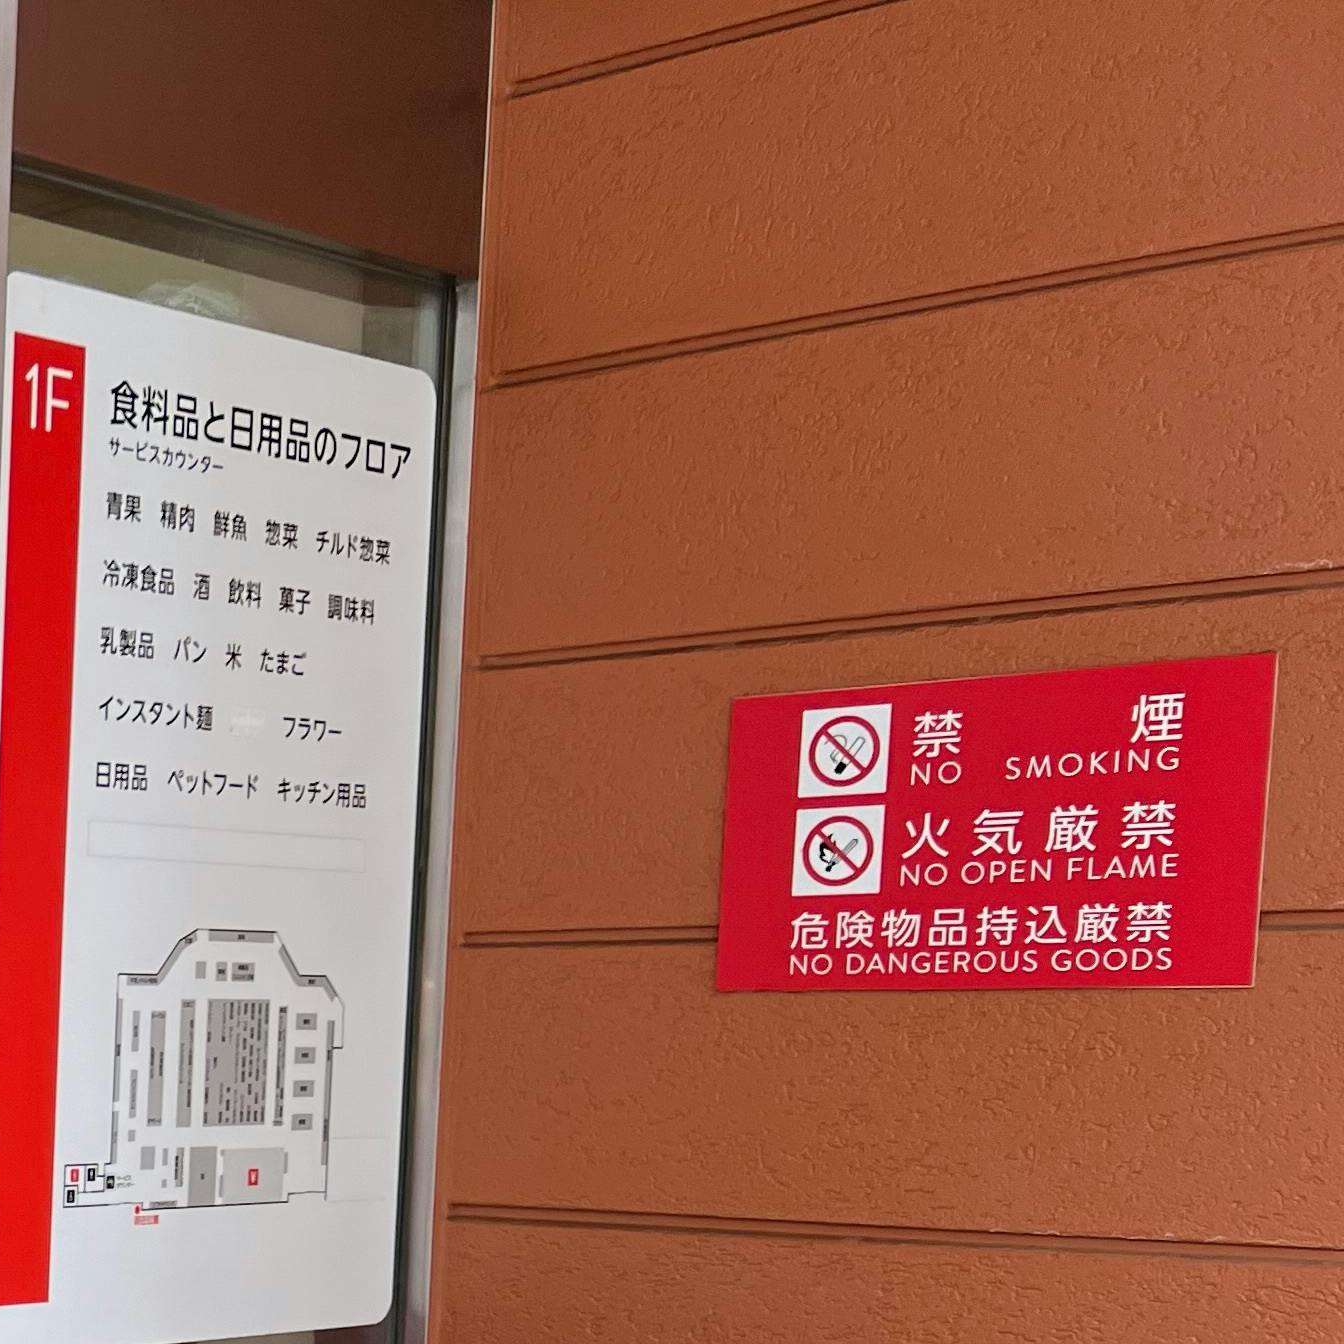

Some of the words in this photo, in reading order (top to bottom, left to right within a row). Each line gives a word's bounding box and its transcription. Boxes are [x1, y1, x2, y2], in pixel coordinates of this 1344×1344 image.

[24, 362, 74, 433] 1F
[109, 380, 412, 480] 食料品と日用品のフロア
[109, 437, 225, 474] サービスカウンター
[105, 491, 143, 524] 青果
[160, 500, 196, 533] 精肉
[213, 510, 248, 542] 鮮魚
[265, 519, 300, 550] 惣菜
[315, 530, 392, 566] チルド惣菜
[102, 559, 176, 597] 冷凍食品
[193, 572, 211, 601] 酒
[228, 577, 263, 609] 飲料
[279, 586, 312, 616] 菓子
[327, 593, 376, 626] 調味料
[100, 626, 155, 660] 乳製品
[173, 635, 209, 664] パン
[225, 643, 243, 671] 米
[259, 648, 308, 677] たまご
[98, 695, 214, 732] インスタント麺
[282, 715, 343, 743] フラワー
[96, 761, 149, 792] 日用品
[168, 769, 259, 800] ペットフード
[276, 777, 367, 809] キッチン用品
[909, 760, 963, 787] NO
[1004, 745, 1181, 783] SMOKING
[900, 799, 1177, 861] 火気厳禁
[899, 862, 949, 888] NO
[959, 857, 1053, 887] OPEN
[1066, 853, 1180, 883] FLAME
[789, 900, 1174, 950] 危険物品持込厳禁
[788, 952, 835, 976] NO
[844, 949, 1040, 976] DANGEROUS
[1050, 946, 1174, 973] GOODS
